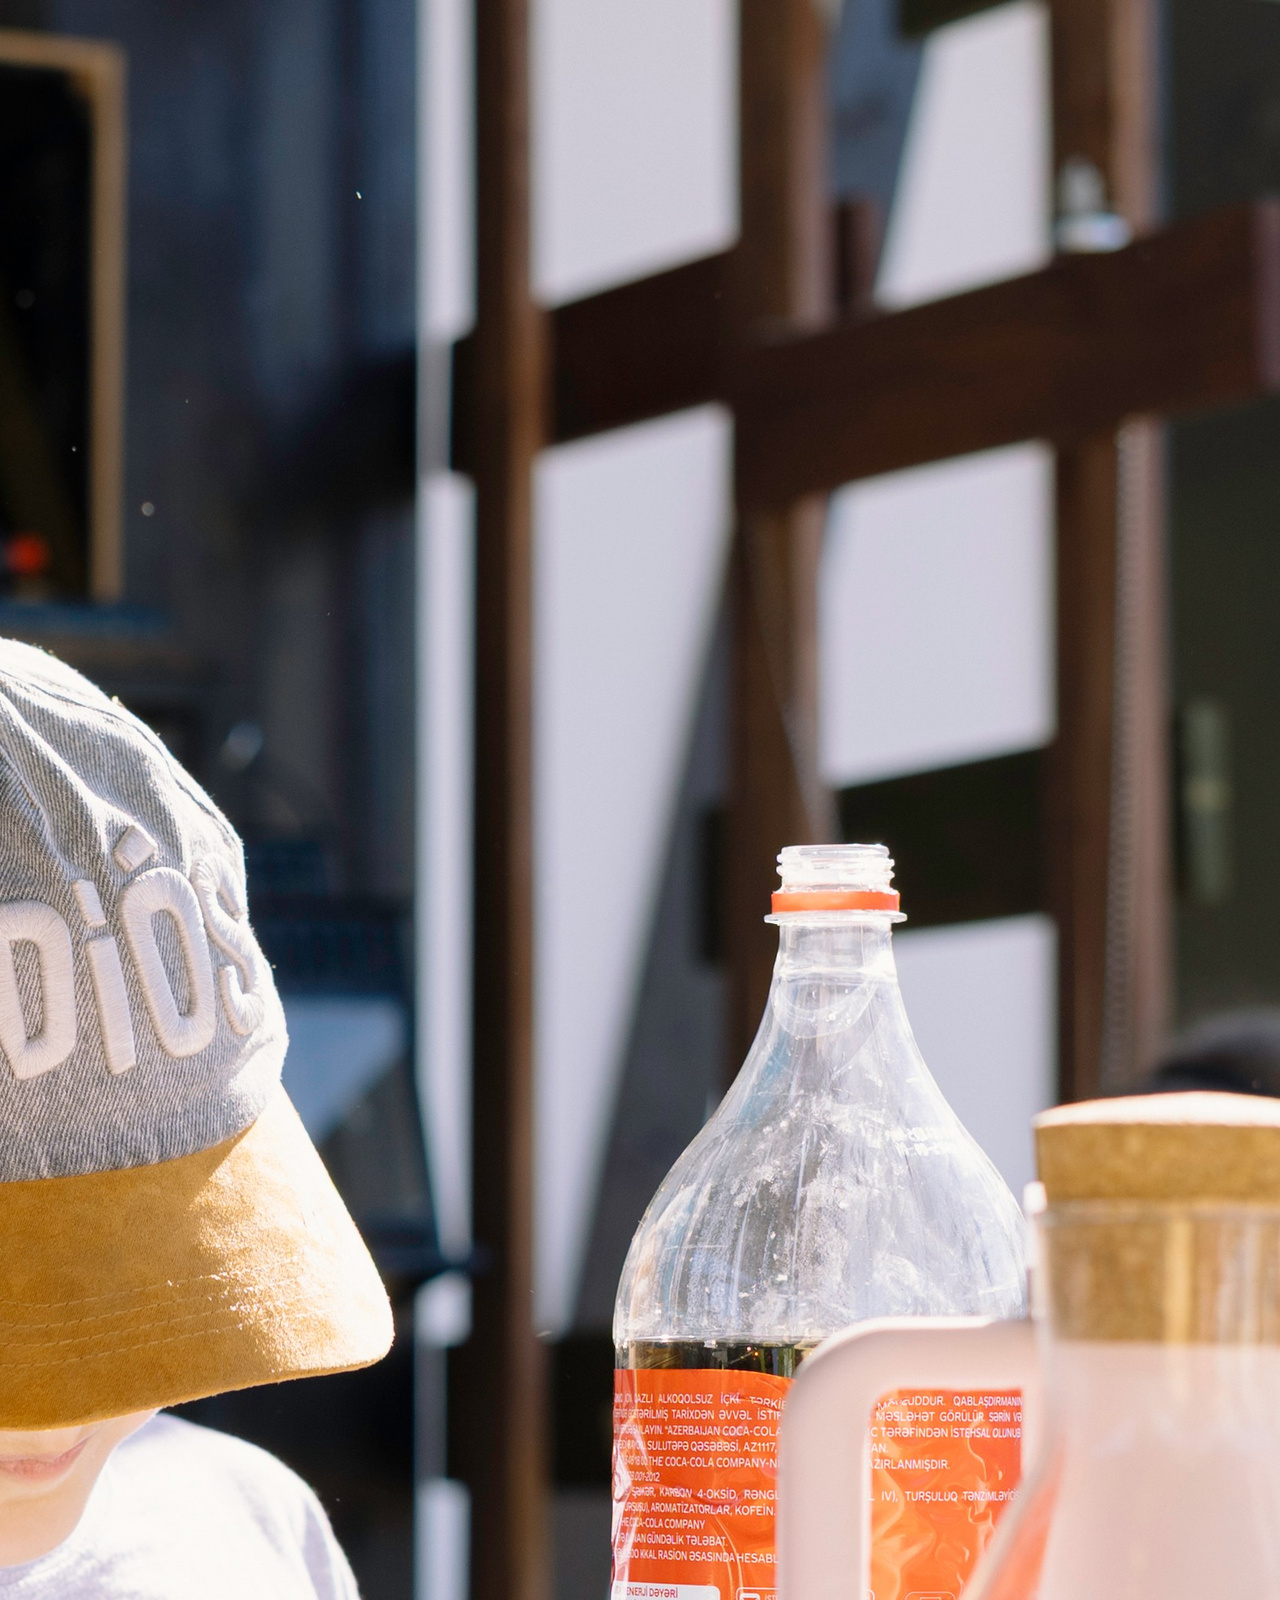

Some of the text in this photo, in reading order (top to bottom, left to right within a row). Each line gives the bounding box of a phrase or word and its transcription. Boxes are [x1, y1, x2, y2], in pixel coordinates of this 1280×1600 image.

[658, 1393, 713, 1404] ALKOQOLSUZ
[671, 1406, 715, 1420] TARİXDƏN
[718, 1409, 753, 1420] ƏVVƏL
[875, 1410, 935, 1422] MƏSLƏHƏT
[988, 1409, 1011, 1422] SƏRİN
[880, 1425, 949, 1438] TƏRƏFİNDƏN
[950, 1425, 991, 1438] İSTEHSAL
[647, 1440, 689, 1451] SULUTƏPƏ
[648, 1456, 664, 1467] THE
[664, 1456, 715, 1468] COCA-COLA
[659, 1486, 693, 1498] KARBON
[696, 1487, 739, 1501] 4-OKSİD,
[904, 1491, 958, 1504] TURŞULUQ
[664, 1518, 706, 1529] COMPANY
[658, 1548, 688, 1561] RASİON
[689, 1551, 735, 1563] ƏSASINDA
[649, 1587, 679, 1599] DƏYƏRİ
